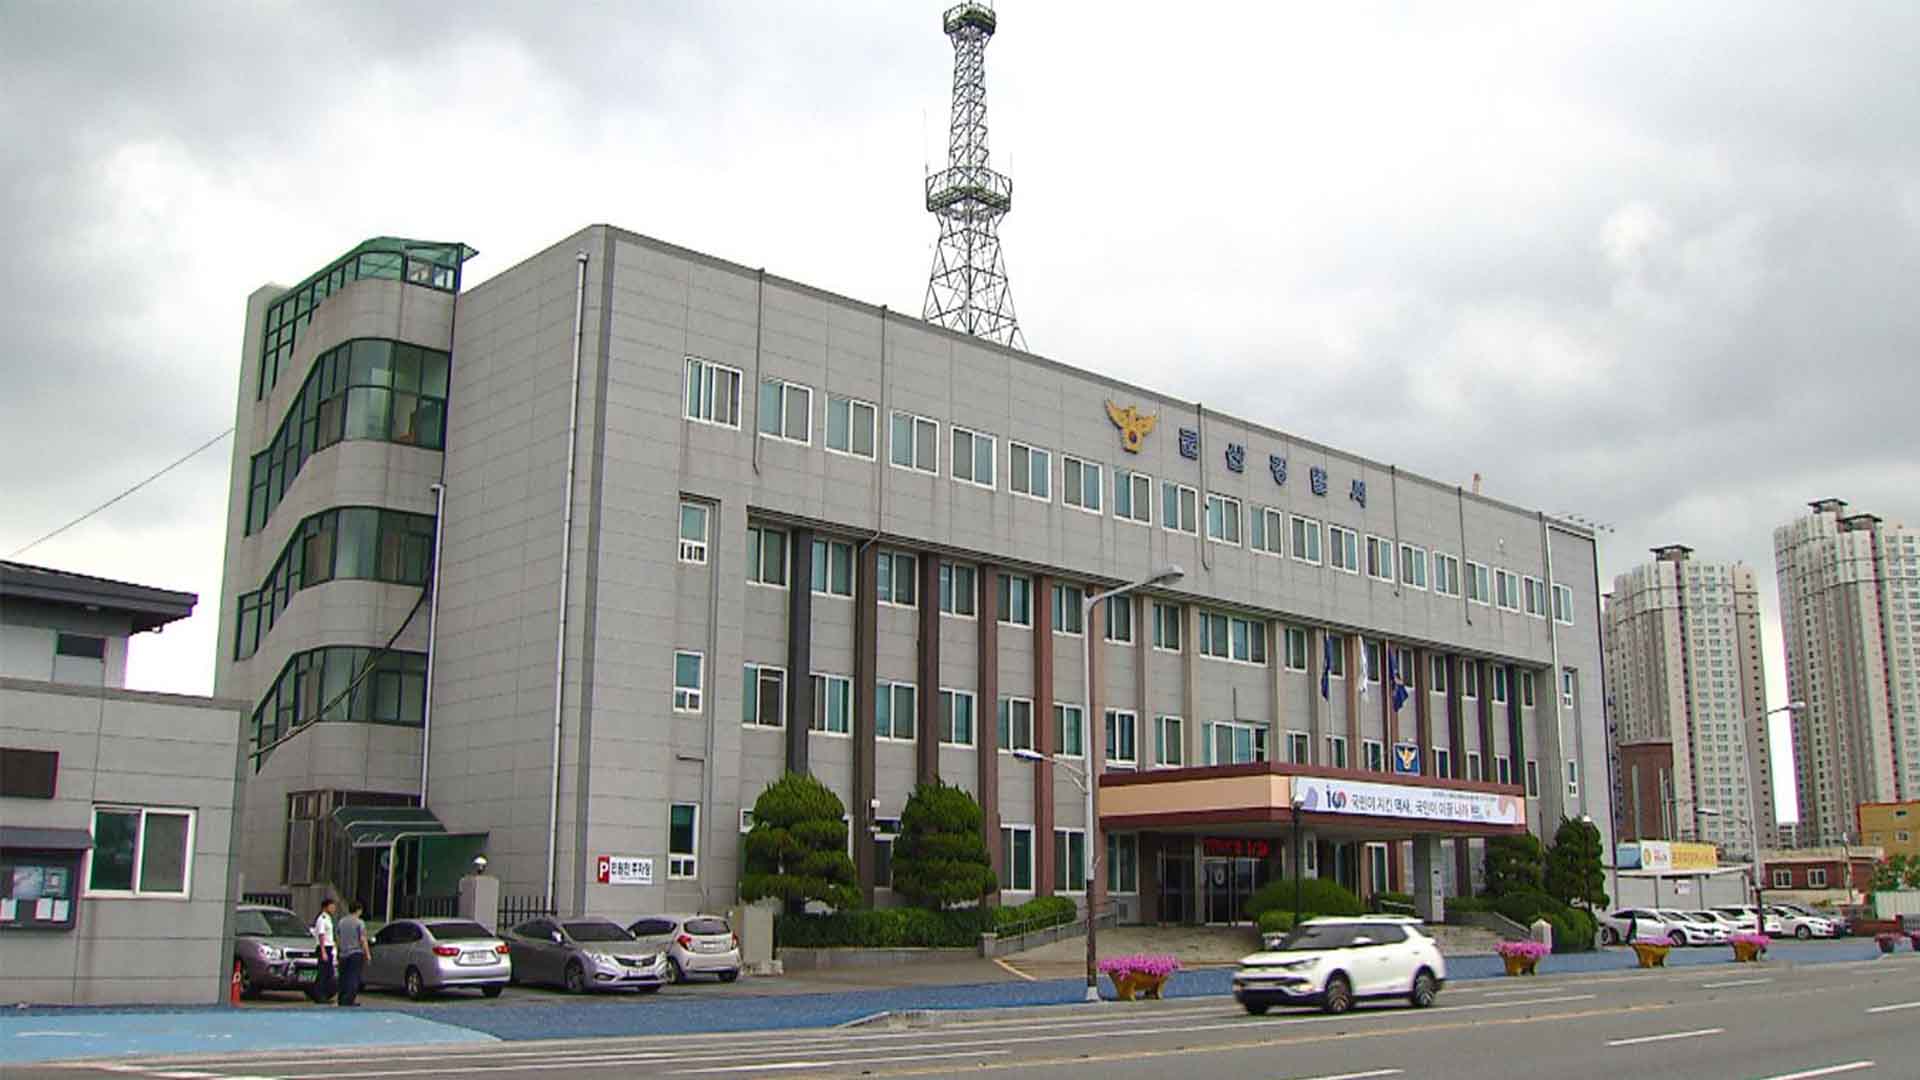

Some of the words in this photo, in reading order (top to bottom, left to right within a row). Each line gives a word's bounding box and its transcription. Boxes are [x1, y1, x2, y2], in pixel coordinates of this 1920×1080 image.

[1351, 793, 1375, 811] 국민이
[600, 862, 609, 879] P
[632, 861, 650, 876] 주차장
